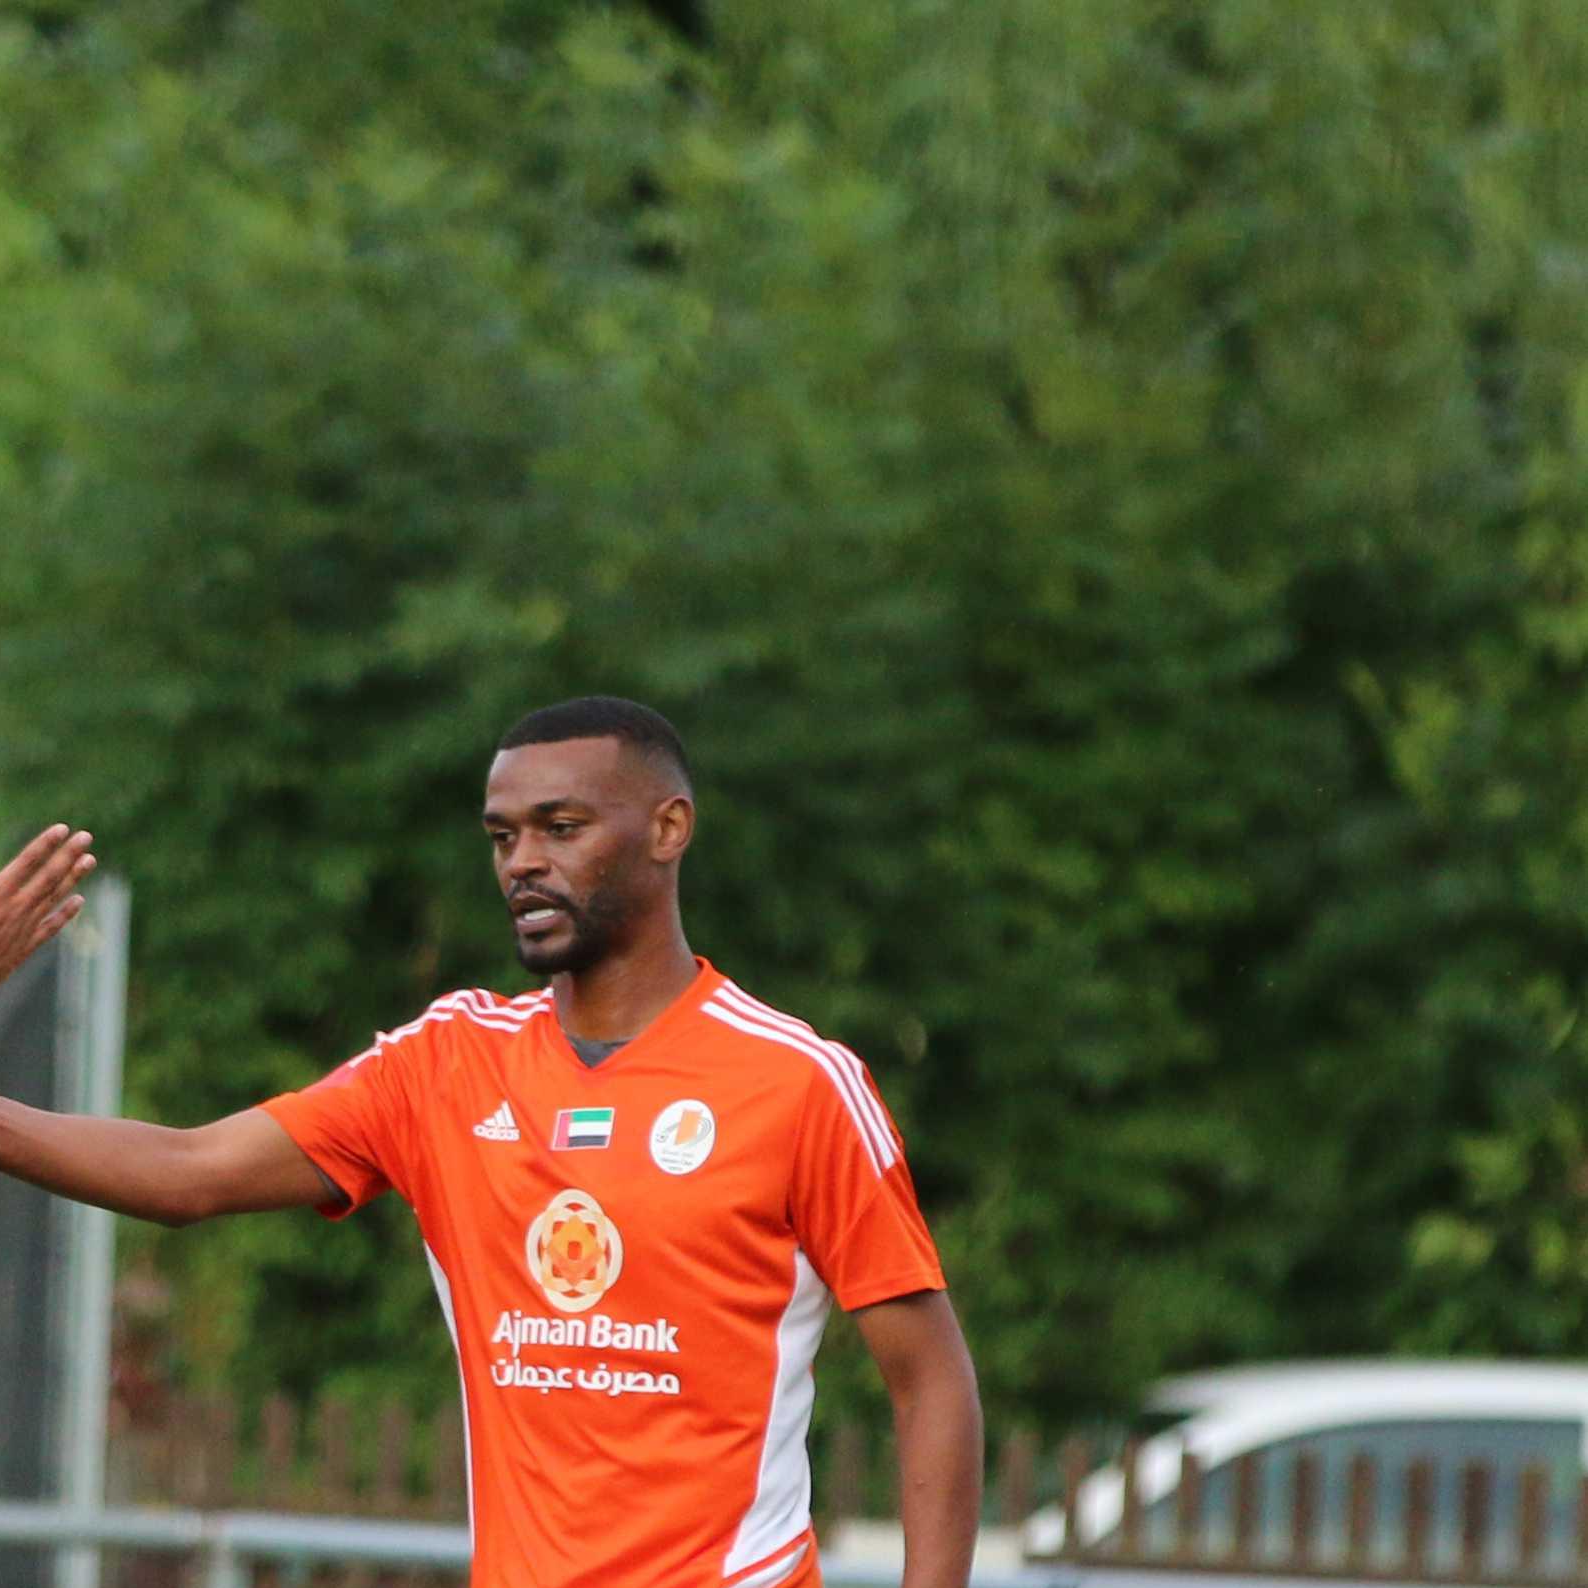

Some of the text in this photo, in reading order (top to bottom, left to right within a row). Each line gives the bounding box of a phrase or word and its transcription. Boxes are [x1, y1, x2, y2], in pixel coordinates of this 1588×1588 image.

[491, 1309, 680, 1358] Ajman Bank
[490, 1357, 681, 1397] مصرف عجمان
